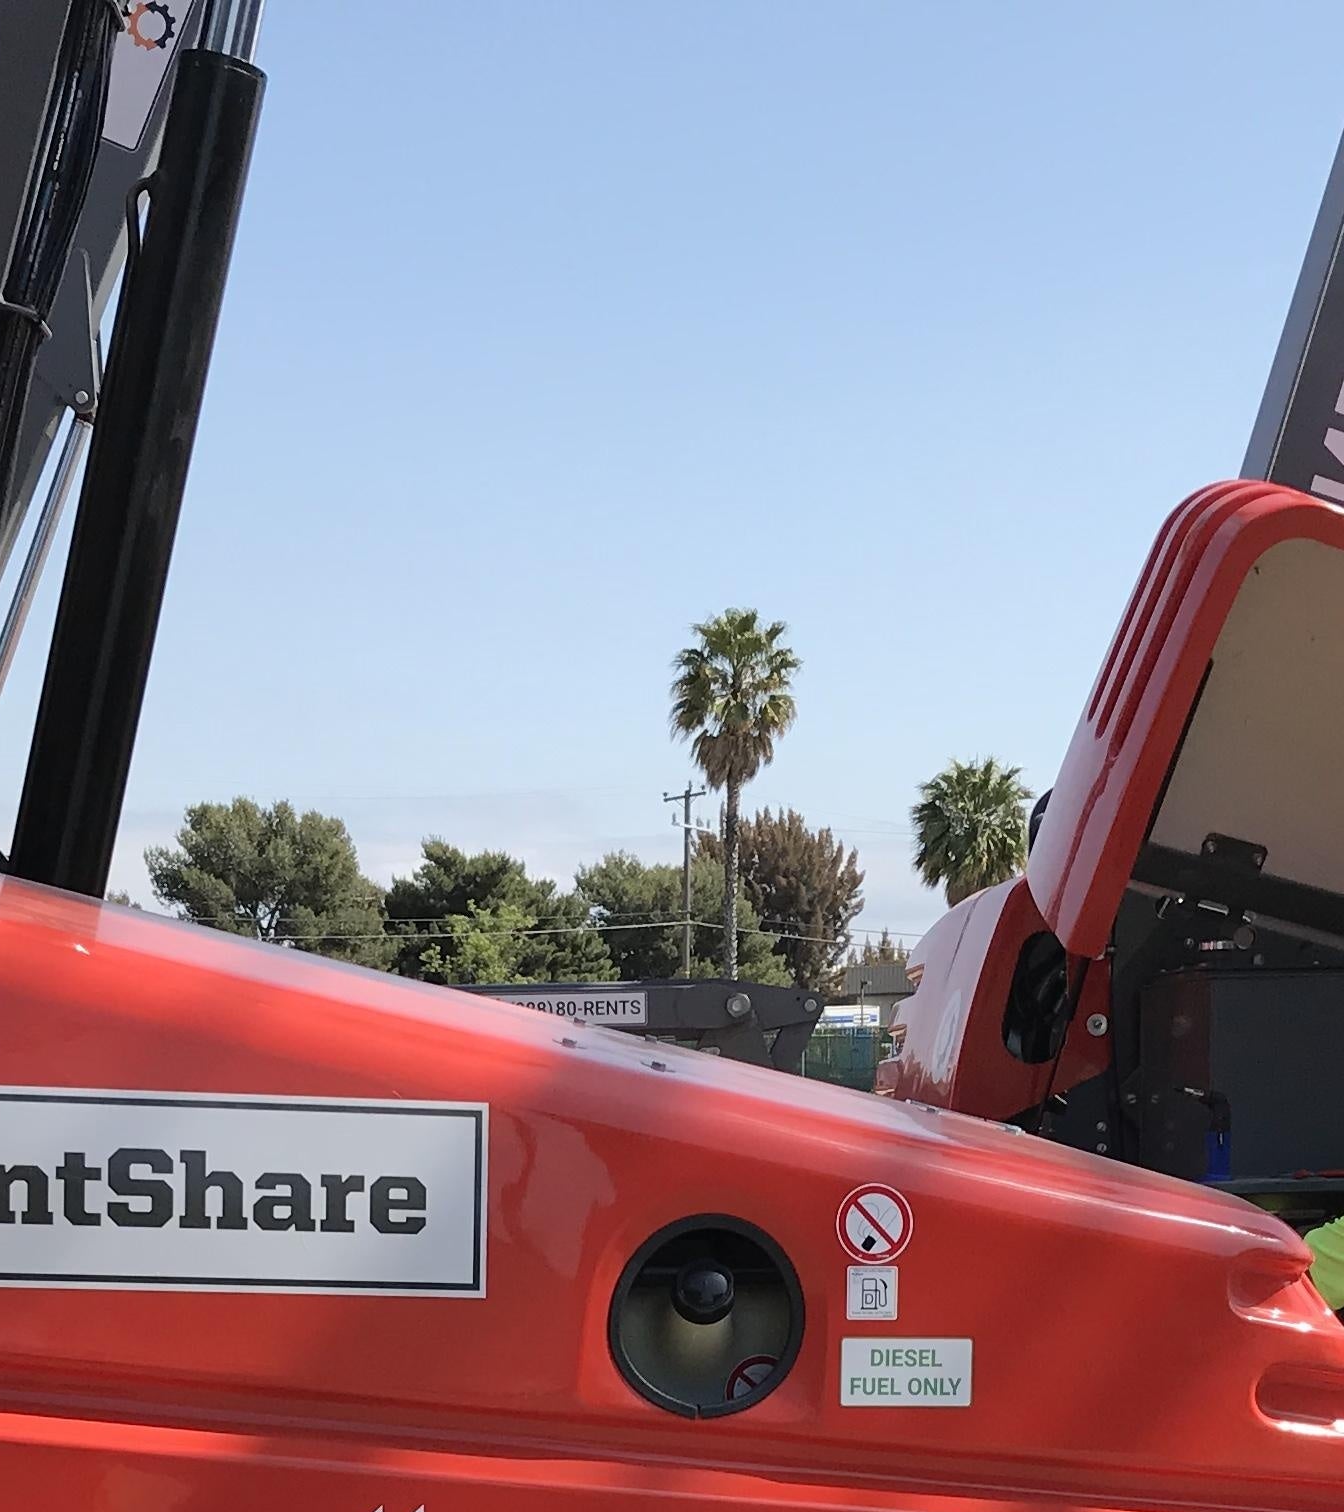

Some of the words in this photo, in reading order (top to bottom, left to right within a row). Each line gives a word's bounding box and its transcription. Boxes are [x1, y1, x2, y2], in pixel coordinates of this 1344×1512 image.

[870, 1349, 943, 1367] DIESEL
[850, 1377, 901, 1395] FUEL
[908, 1377, 962, 1396] ONLY
